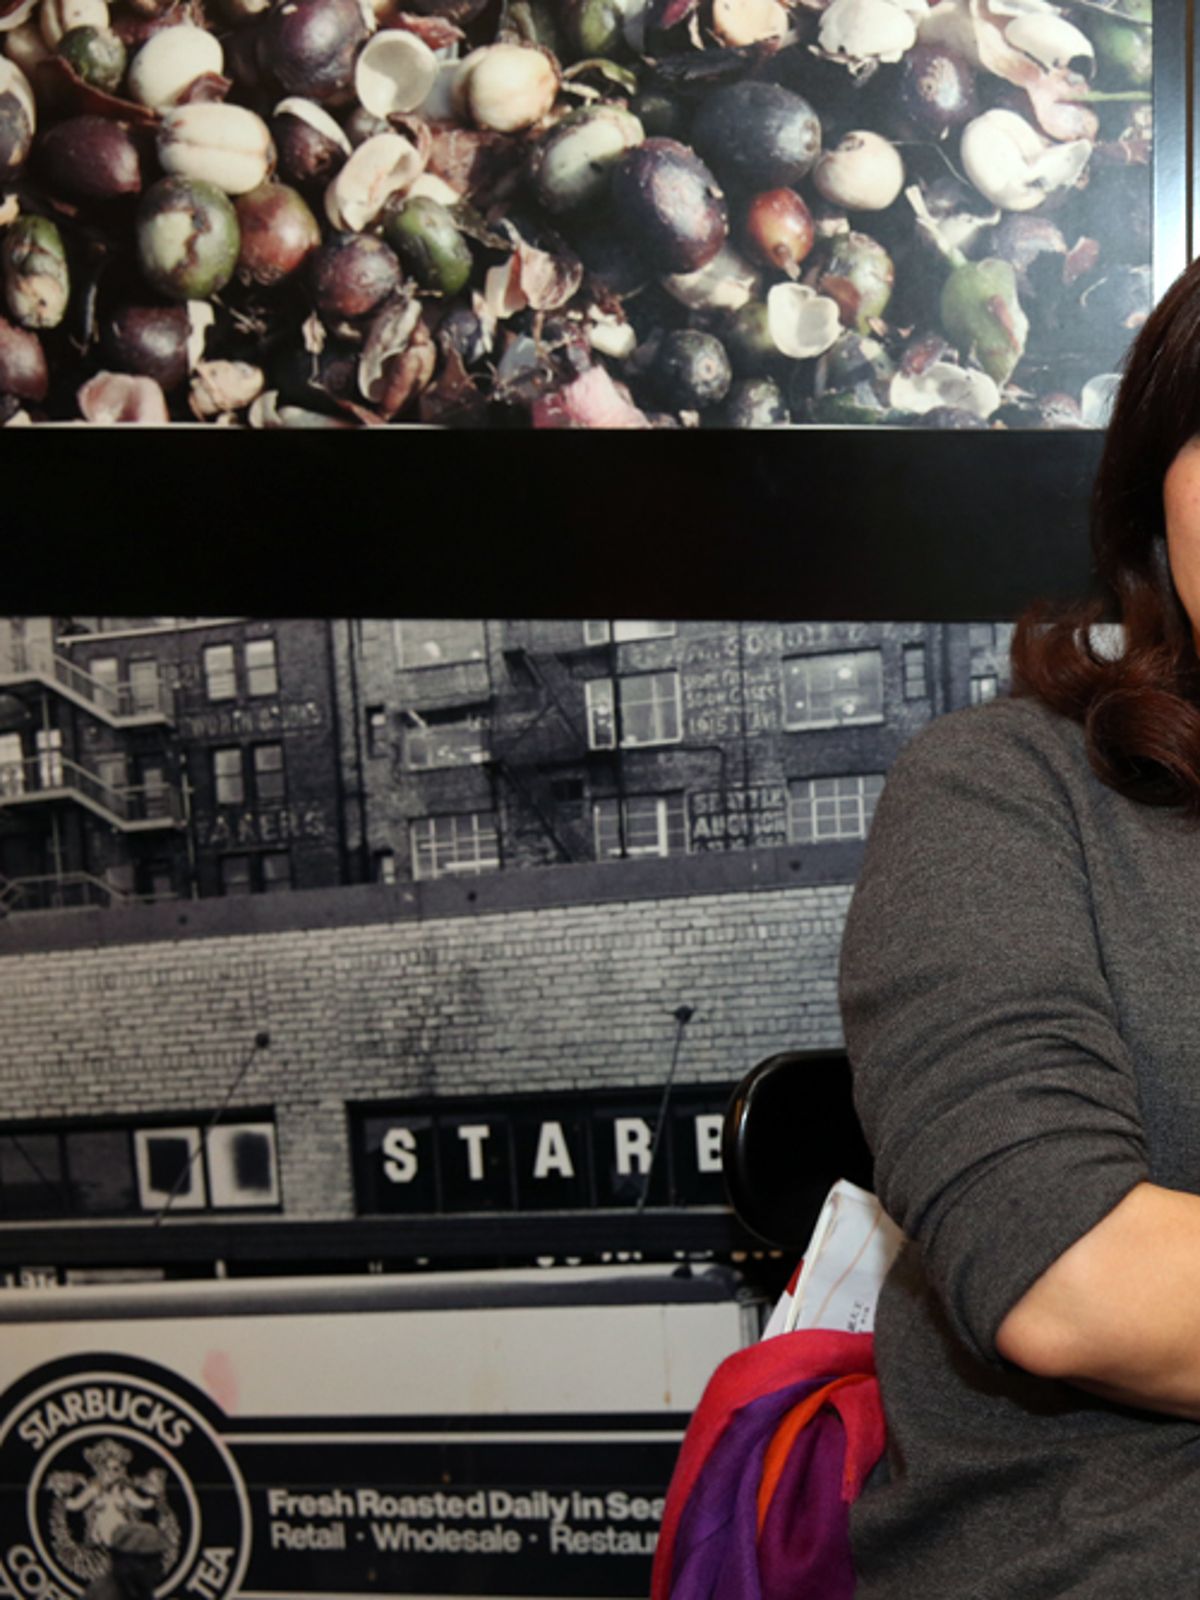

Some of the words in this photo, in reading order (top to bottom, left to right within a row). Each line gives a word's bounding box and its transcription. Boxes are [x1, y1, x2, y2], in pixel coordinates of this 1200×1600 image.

[17, 1387, 192, 1450] STARBUCKS
[267, 1488, 354, 1518] Fresh
[355, 1488, 486, 1519] Roasted
[488, 1490, 570, 1524] Daily
[270, 1521, 346, 1550] Retail
[370, 1522, 522, 1554] Wholesale
